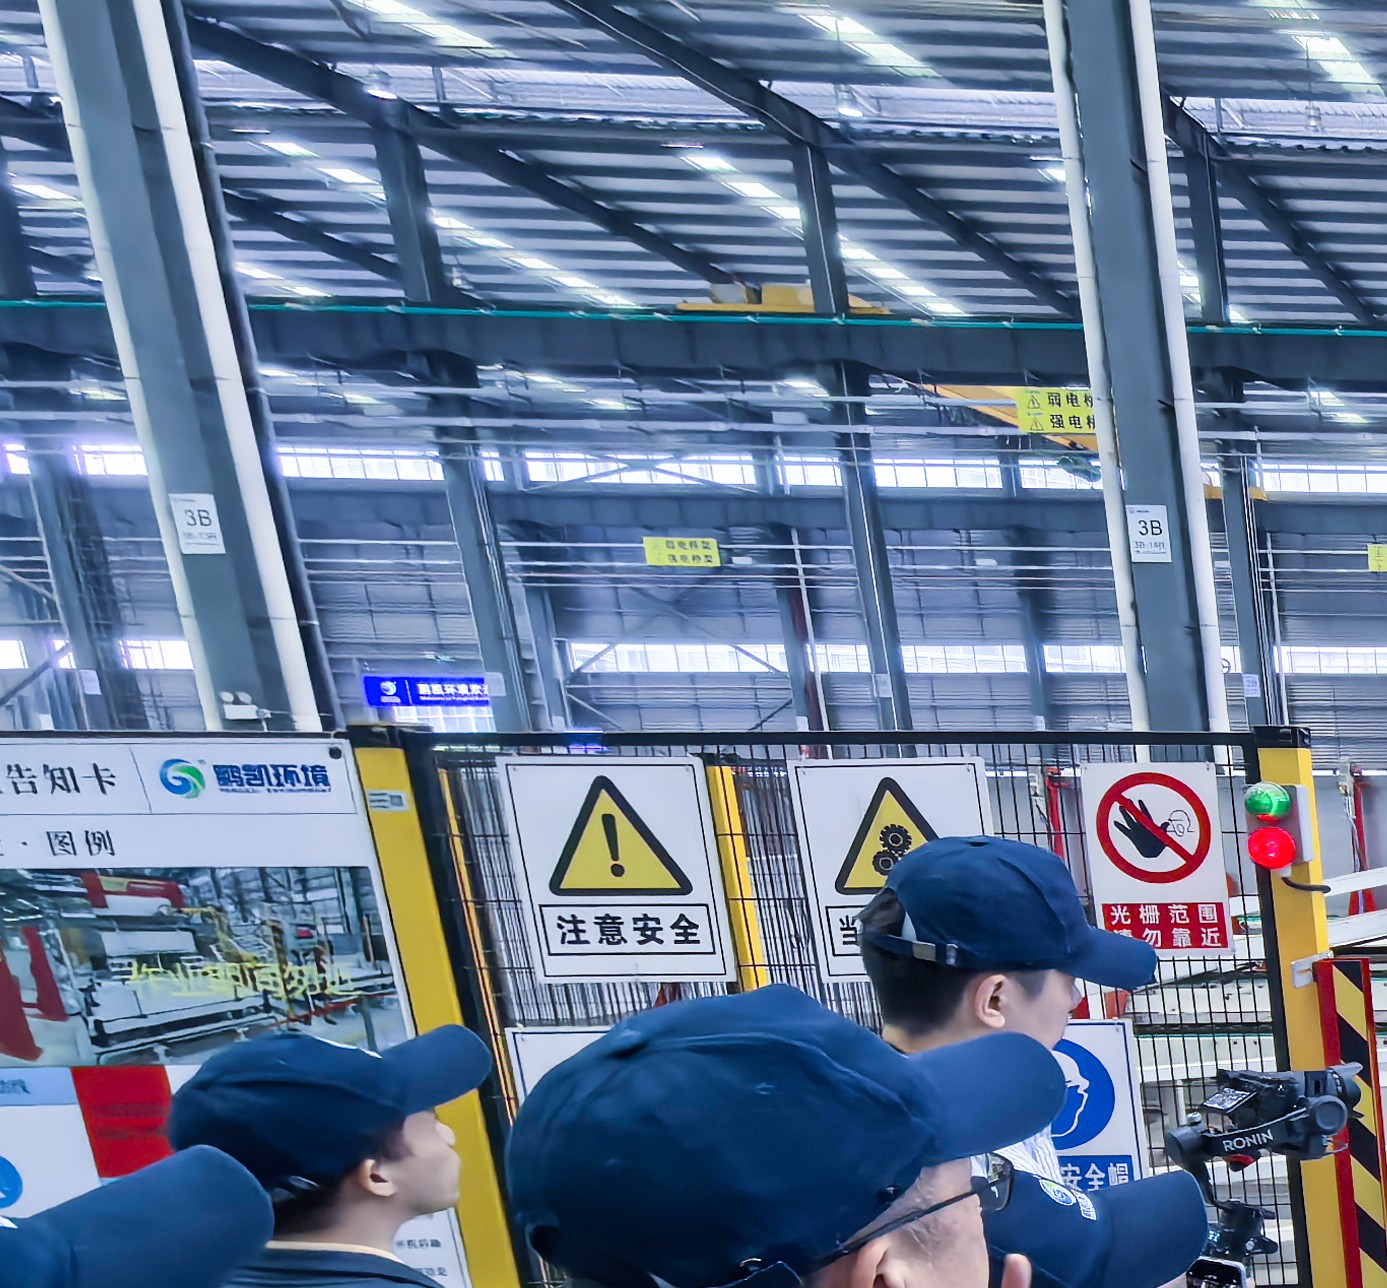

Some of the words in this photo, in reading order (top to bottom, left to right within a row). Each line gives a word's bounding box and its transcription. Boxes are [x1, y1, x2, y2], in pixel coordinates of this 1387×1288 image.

[184, 508, 213, 527] 3B
[1138, 519, 1163, 536] 3B
[0, 763, 117, 796] 告知卡
[212, 764, 331, 787] 鹏凯环境
[1110, 903, 1219, 926] 光栅范围
[556, 913, 701, 946] 注意安全
[1222, 1129, 1274, 1152] RONIN
[1060, 1162, 1129, 1192] 安全帽
